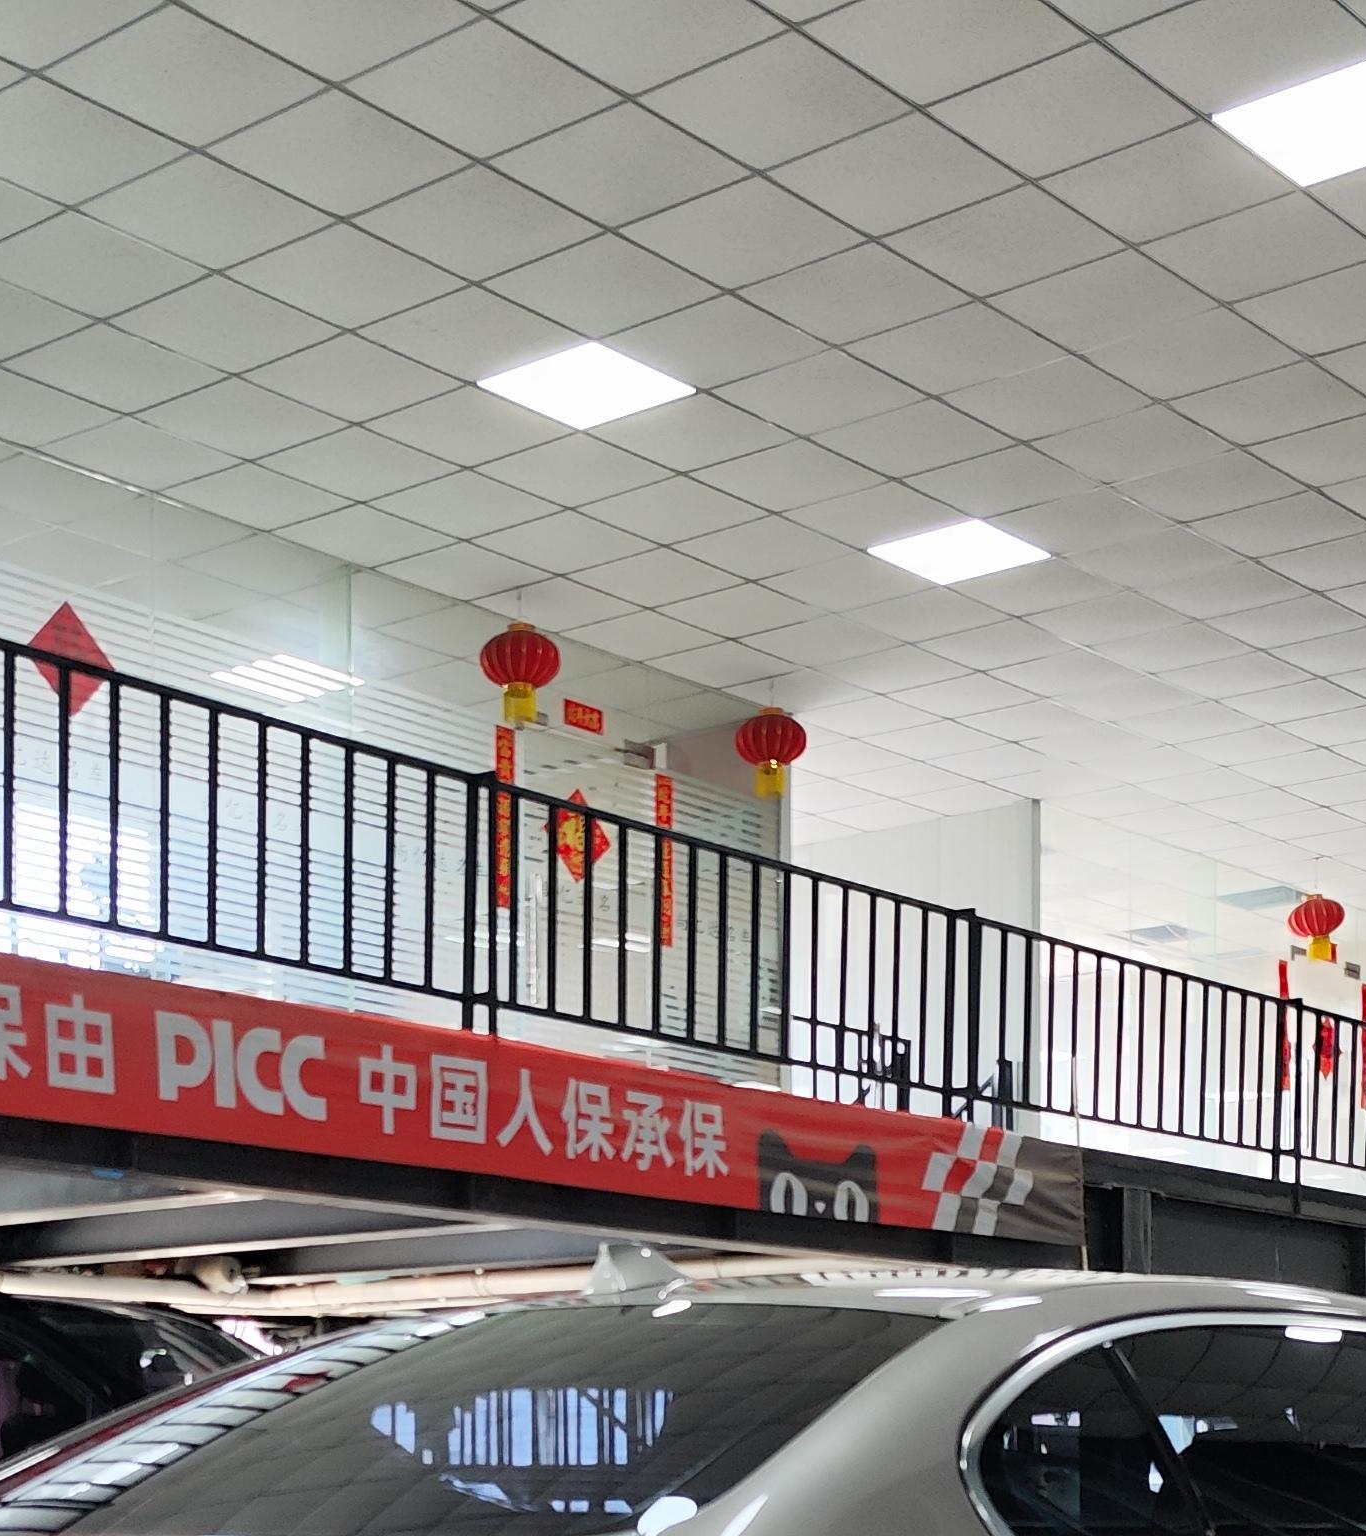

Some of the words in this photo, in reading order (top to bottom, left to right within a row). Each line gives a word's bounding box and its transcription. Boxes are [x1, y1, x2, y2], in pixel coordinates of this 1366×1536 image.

[156, 1009, 328, 1122] PICC
[357, 1043, 730, 1180] 中国人保承保
